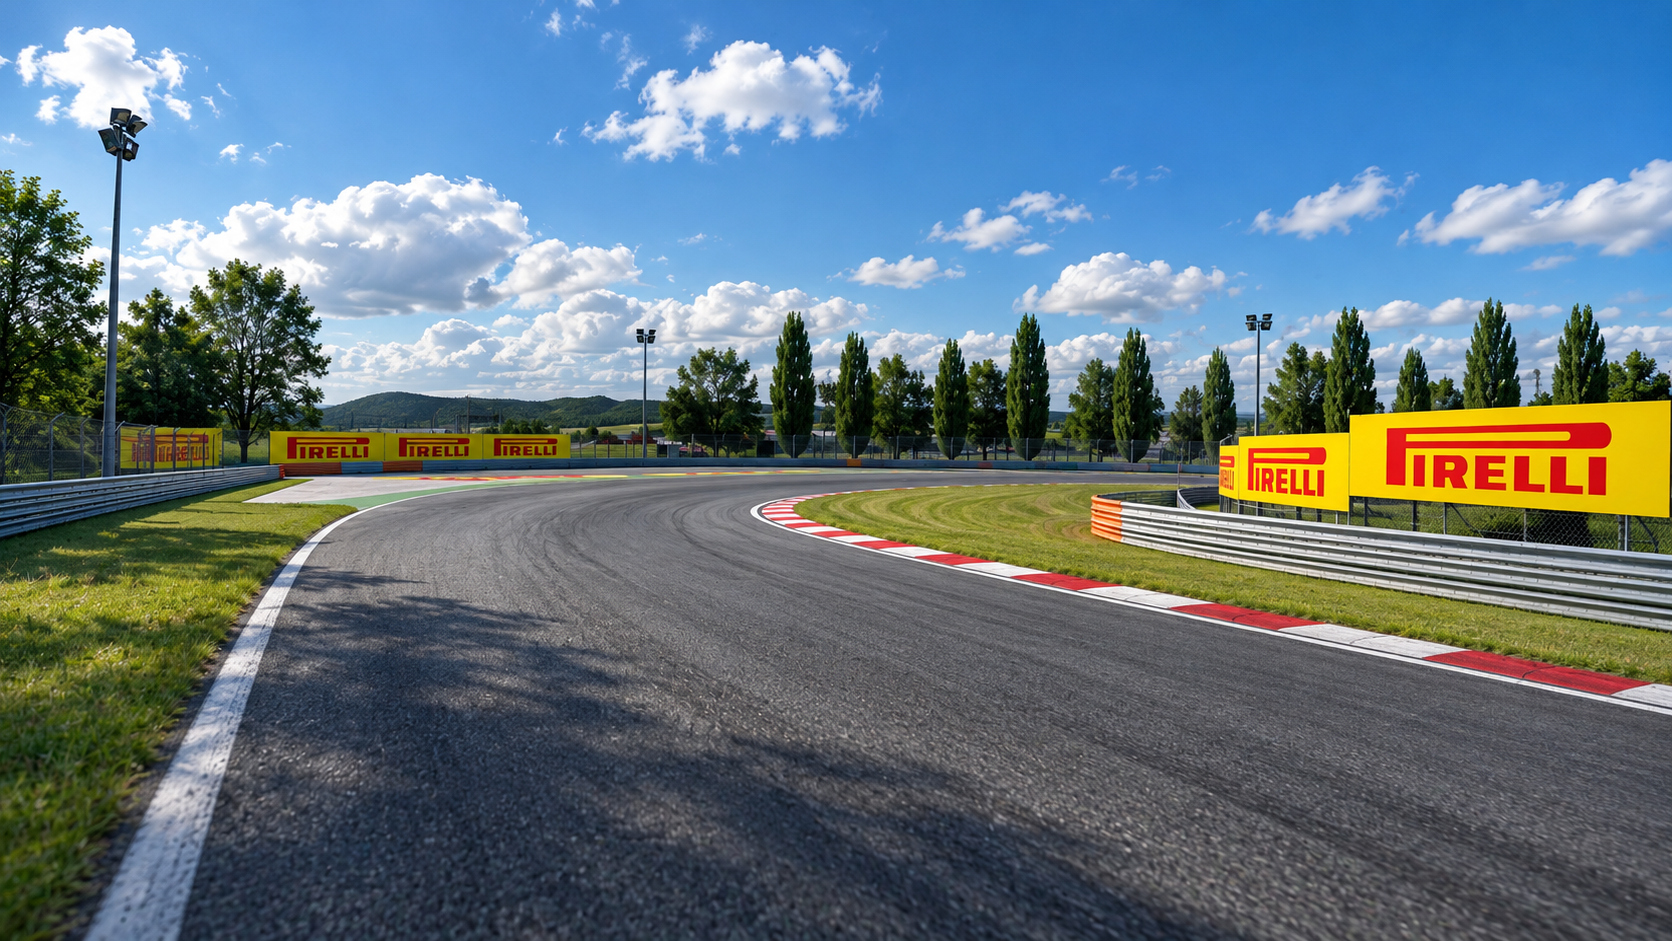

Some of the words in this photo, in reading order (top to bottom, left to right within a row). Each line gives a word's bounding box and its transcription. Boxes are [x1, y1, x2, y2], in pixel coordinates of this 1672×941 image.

[287, 437, 370, 459] PIRELLI
[399, 437, 470, 457] PIRELLI
[494, 438, 558, 457] PIRELLI
[1386, 422, 1612, 496] PIRELLI
[1248, 447, 1327, 497] PIRELLI
